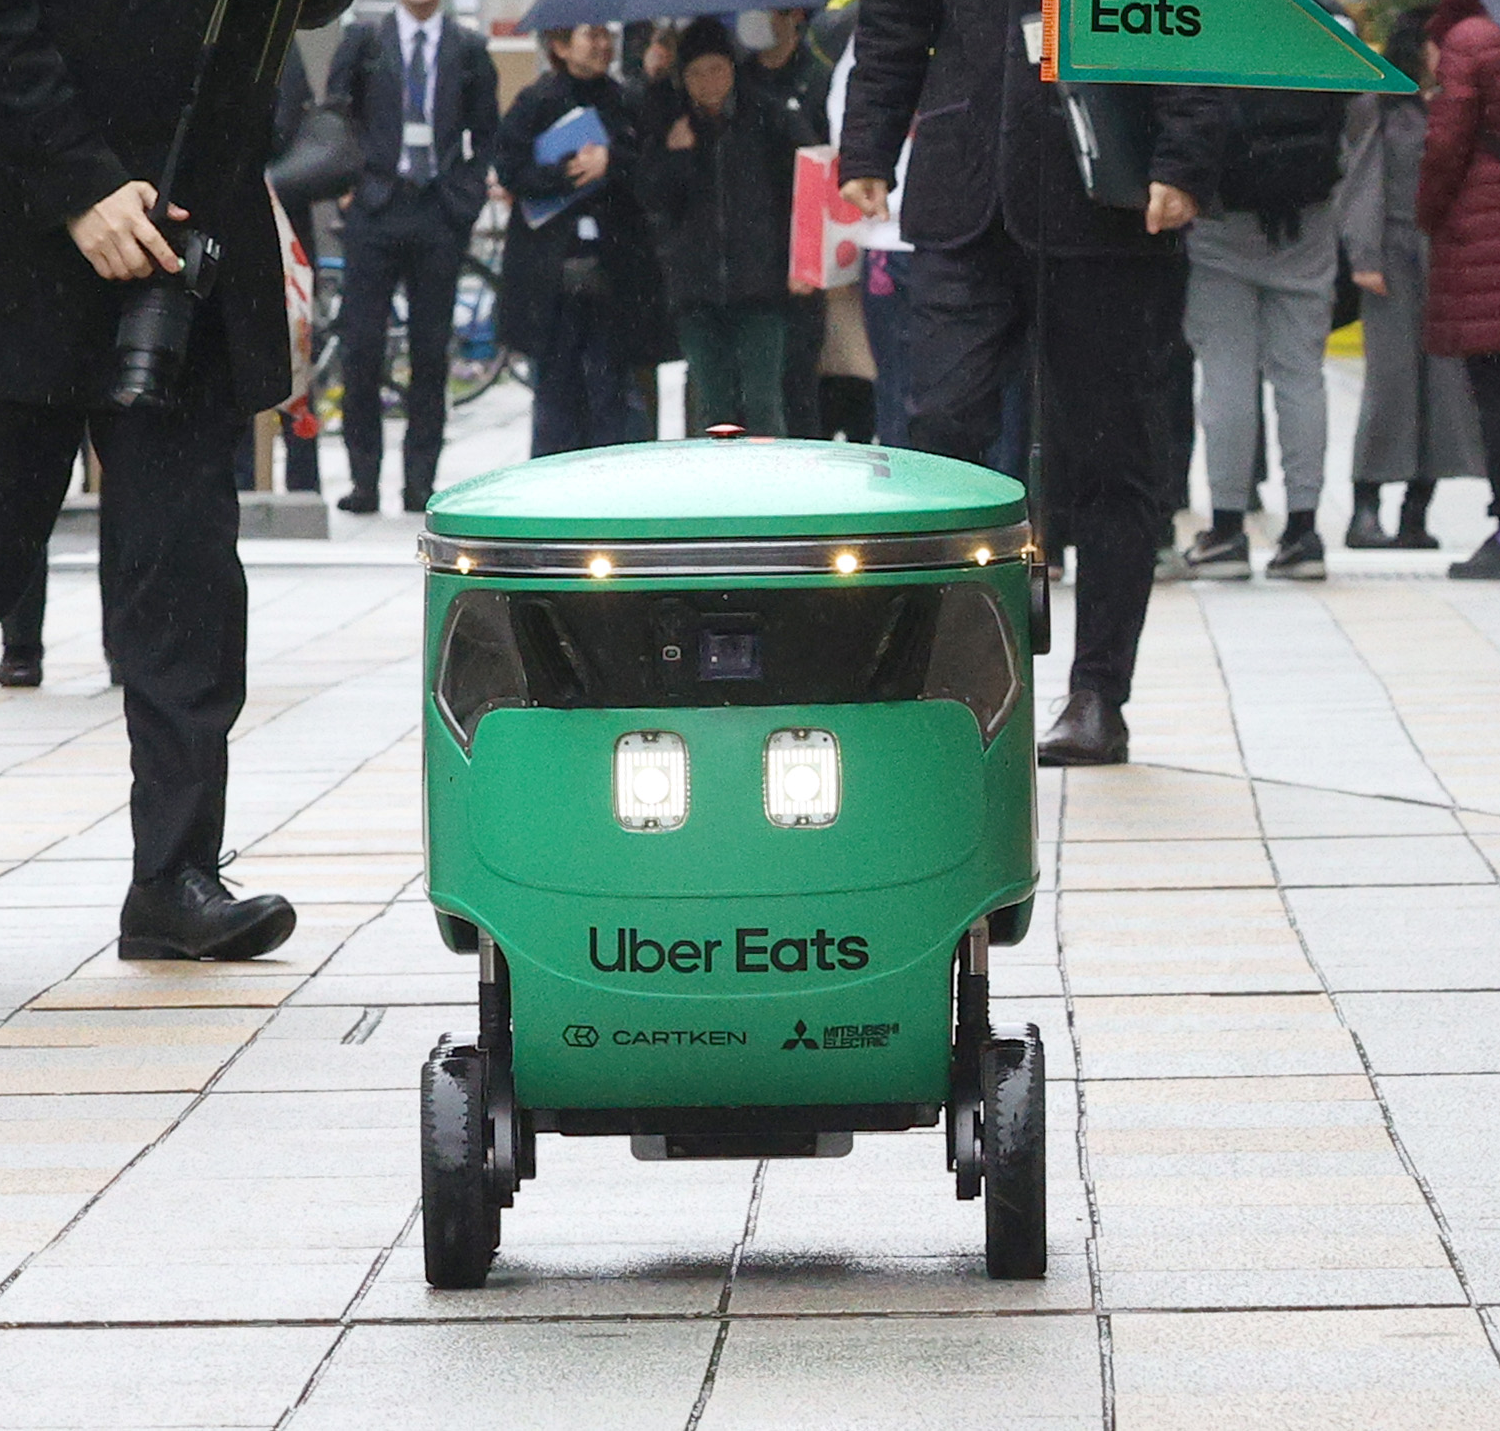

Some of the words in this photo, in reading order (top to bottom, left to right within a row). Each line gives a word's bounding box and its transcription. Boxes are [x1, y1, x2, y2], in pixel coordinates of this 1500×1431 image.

[589, 926, 722, 973] Uber
[735, 927, 870, 972] Eats
[824, 1023, 900, 1037] MITSUBISHI
[612, 1030, 747, 1046] CARTKEN
[823, 1036, 888, 1049] ELECTRIC
